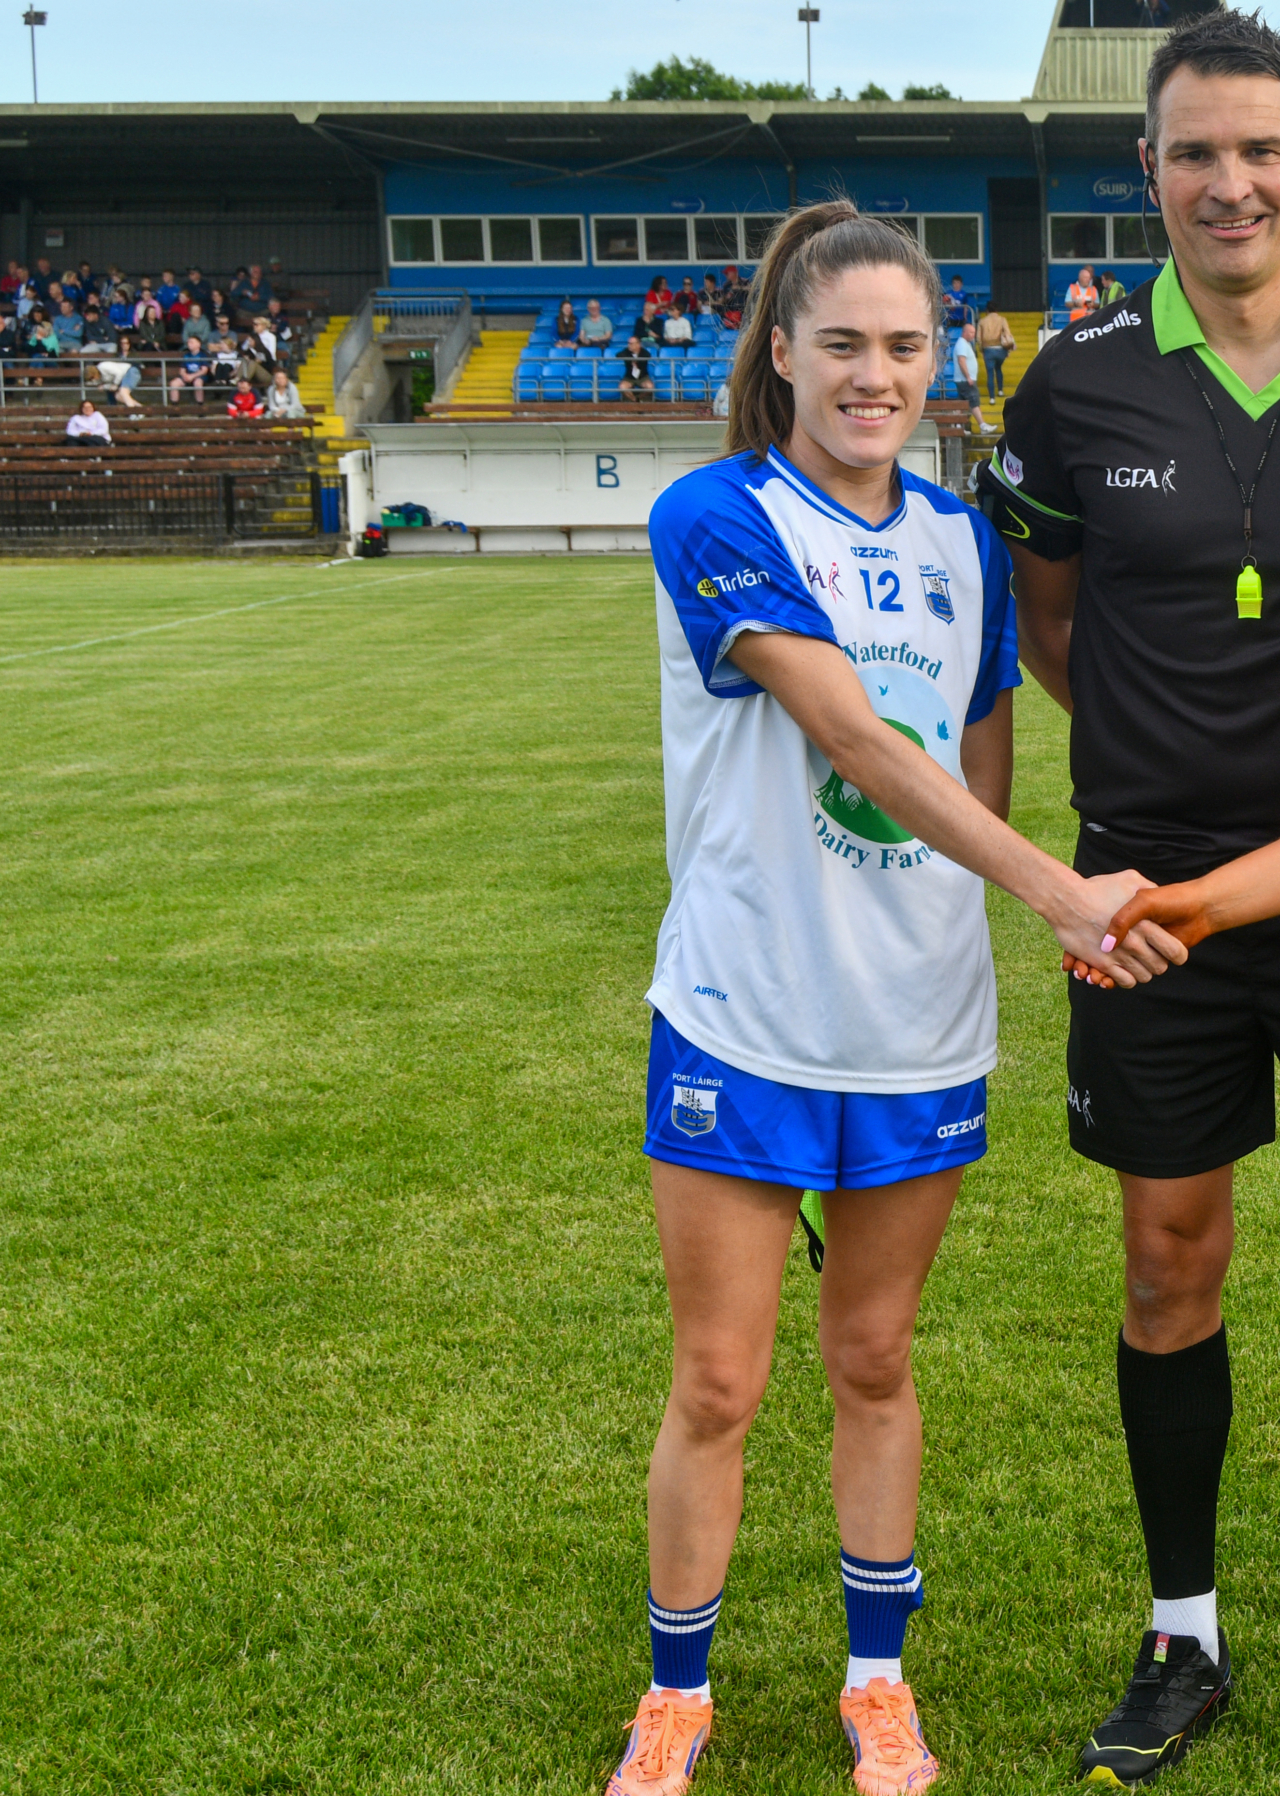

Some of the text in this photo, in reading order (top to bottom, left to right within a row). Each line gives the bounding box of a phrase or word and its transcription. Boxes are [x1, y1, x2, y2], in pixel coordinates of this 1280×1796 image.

[1099, 183, 1128, 195] SUIR
[596, 454, 620, 488] B
[1105, 467, 1160, 488] LGFA
[850, 546, 899, 561] azzurri
[712, 568, 771, 592] Tirlán
[858, 568, 904, 612] 12
[813, 811, 871, 869] Dairy
[672, 1072, 723, 1087] PORT LÁIRGE
